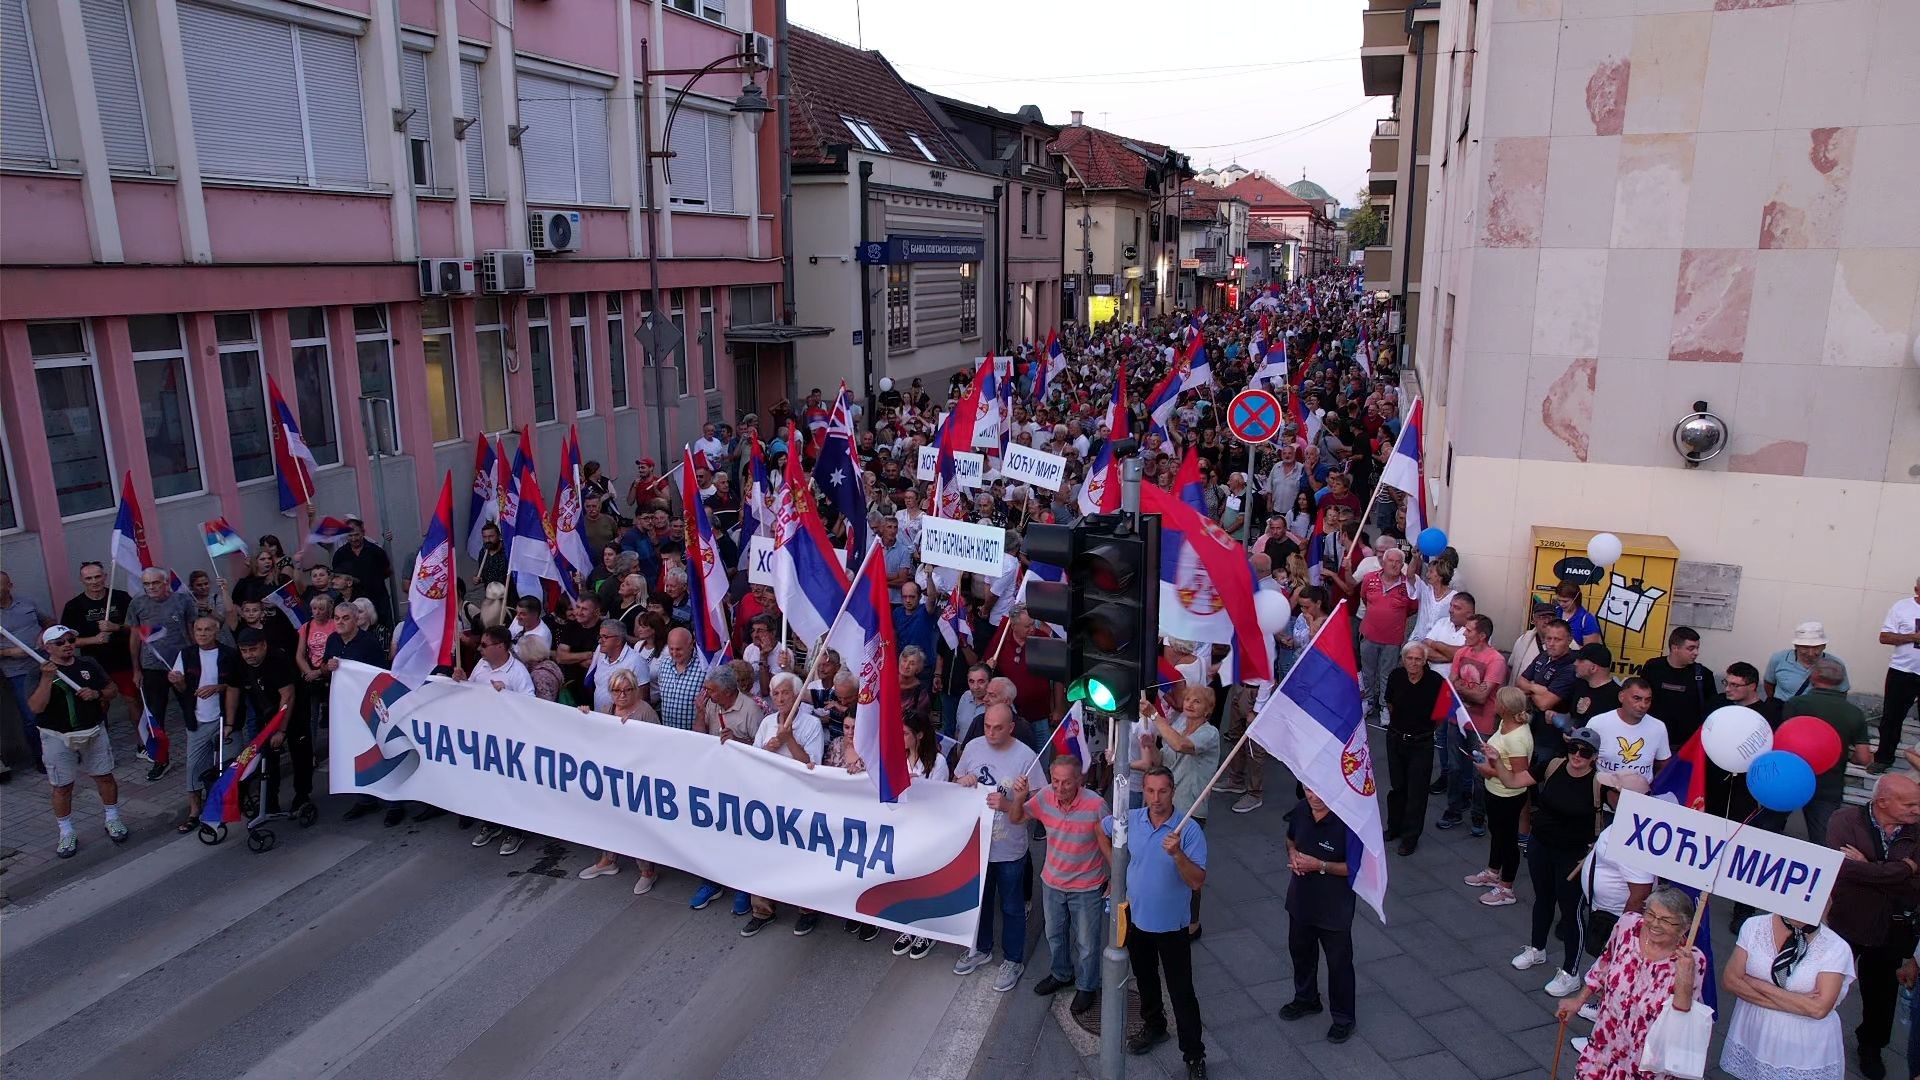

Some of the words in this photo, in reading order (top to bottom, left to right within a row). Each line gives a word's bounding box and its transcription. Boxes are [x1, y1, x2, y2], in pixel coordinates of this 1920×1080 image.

[921, 454, 937, 471] ХОЋ
[954, 459, 981, 479] РАДИМ!
[1007, 452, 1035, 475] ХОЋУ
[1035, 459, 1061, 482] МИР!
[925, 528, 943, 554] ХОЋУ
[942, 530, 976, 560] НОРМАЛАН
[975, 536, 1001, 564] ЖИВОТ!
[1539, 539, 1566, 548] 32804
[1565, 567, 1591, 576] ЛАКО
[411, 719, 527, 783] ЧАЧАК
[533, 747, 680, 821] ПРОТИВ
[688, 785, 896, 879] БЛОКАДА
[1624, 813, 1726, 870] ХОЋУ
[1727, 844, 1822, 902] МИР!
